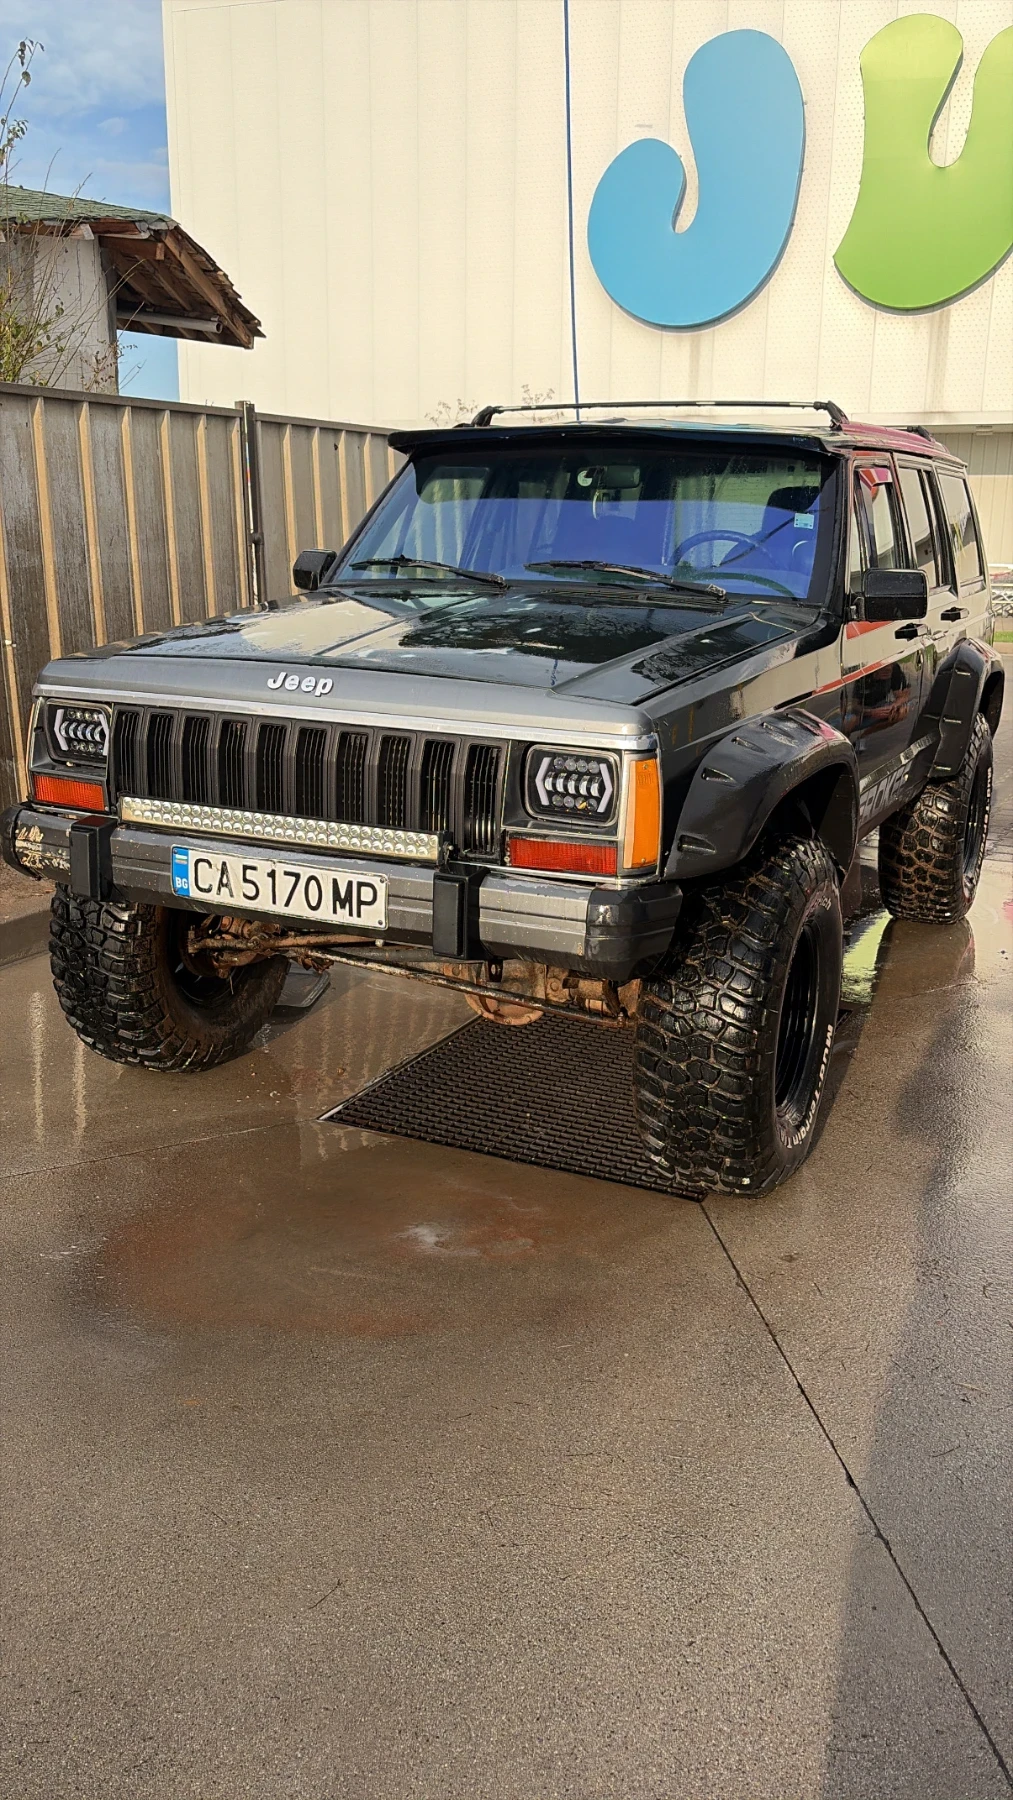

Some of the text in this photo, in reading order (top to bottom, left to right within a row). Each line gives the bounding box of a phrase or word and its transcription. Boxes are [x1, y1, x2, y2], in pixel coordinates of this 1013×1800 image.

[266, 671, 333, 697] Jeep
[175, 876, 188, 889] BG
[193, 857, 378, 918] CA 5170 MP
[792, 1024, 834, 1146] Mud-Terrain
